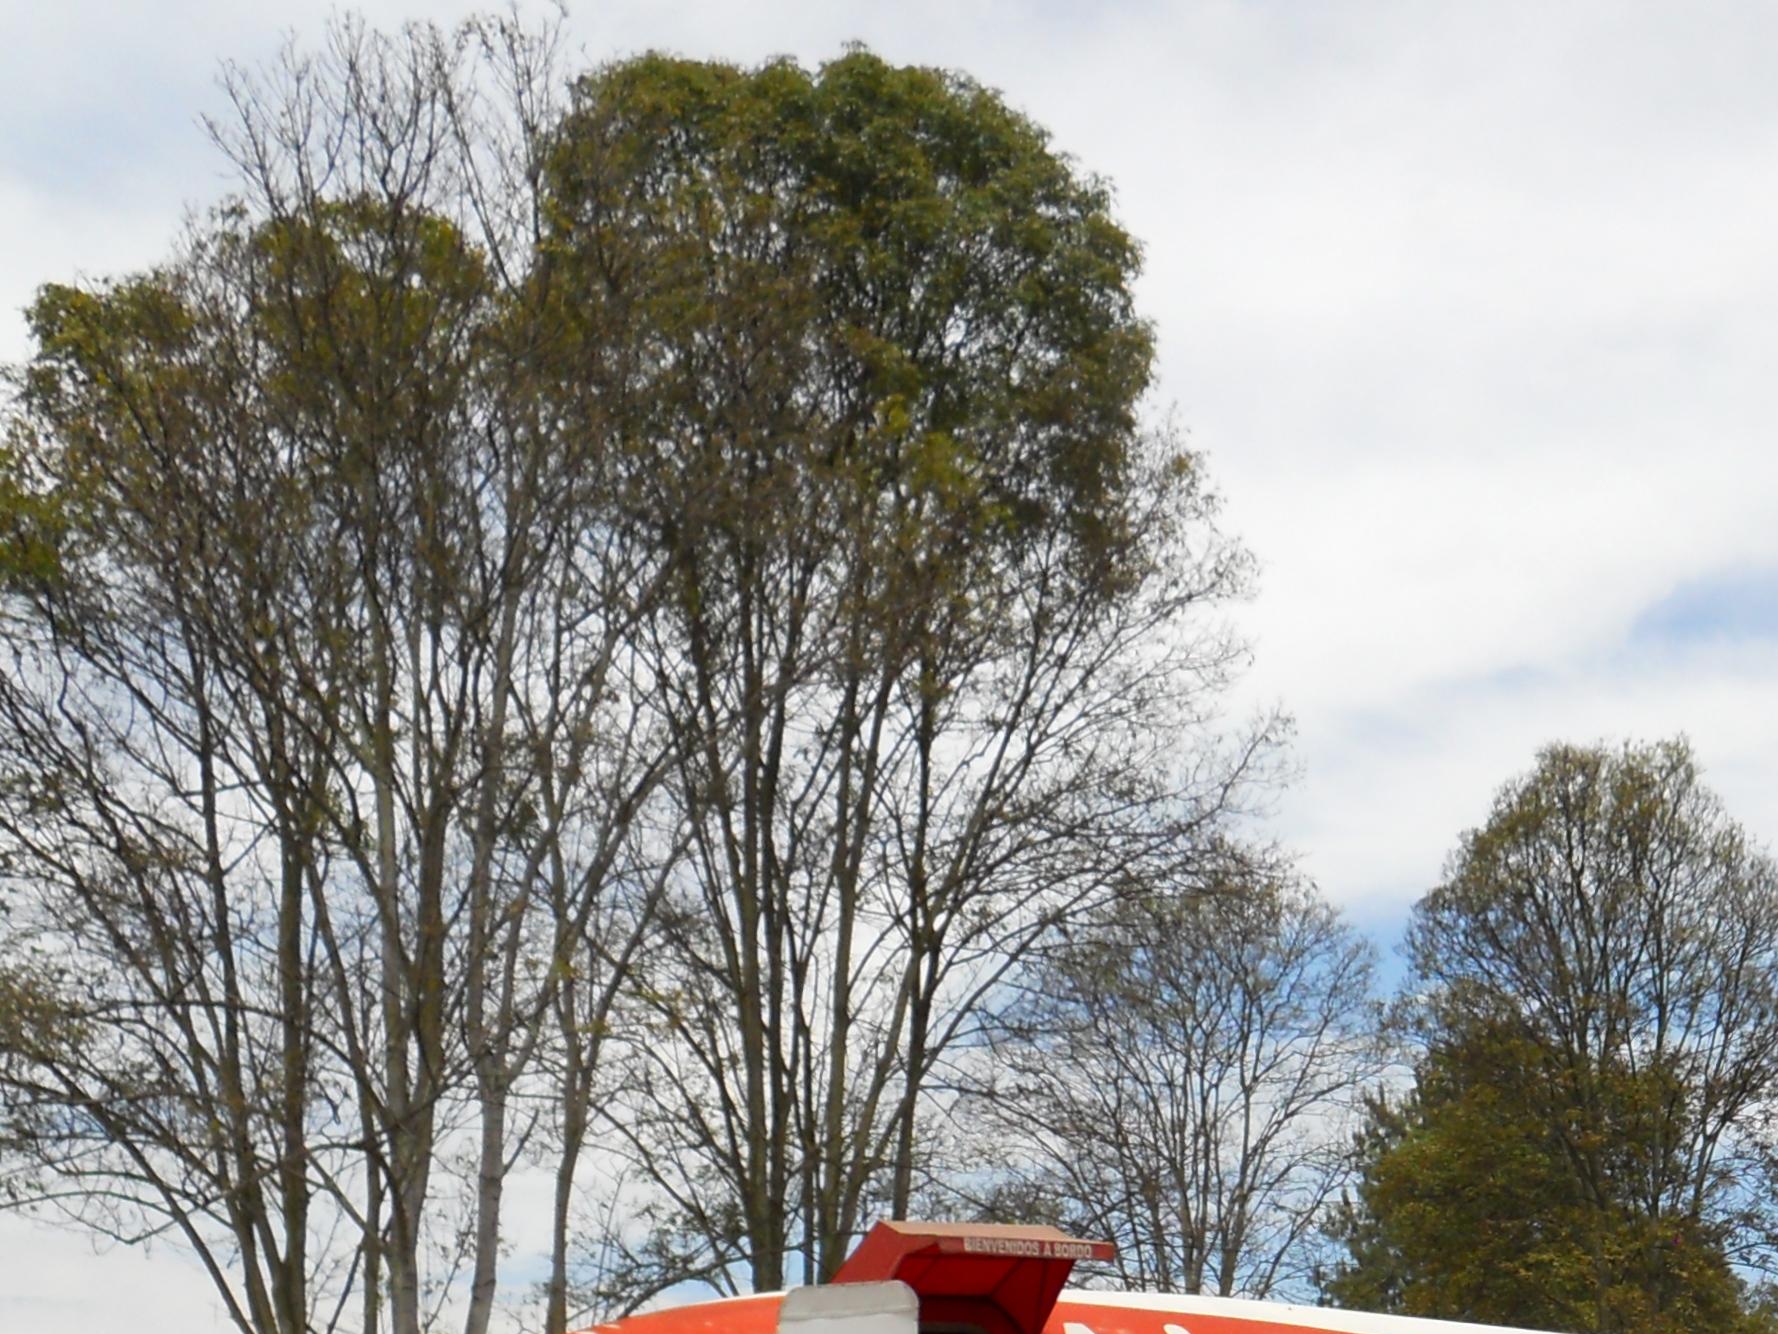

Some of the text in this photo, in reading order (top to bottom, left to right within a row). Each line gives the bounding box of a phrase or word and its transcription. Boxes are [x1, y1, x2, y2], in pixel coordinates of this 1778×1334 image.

[964, 1238, 1093, 1259] BIENVENIDOS A BORDO
